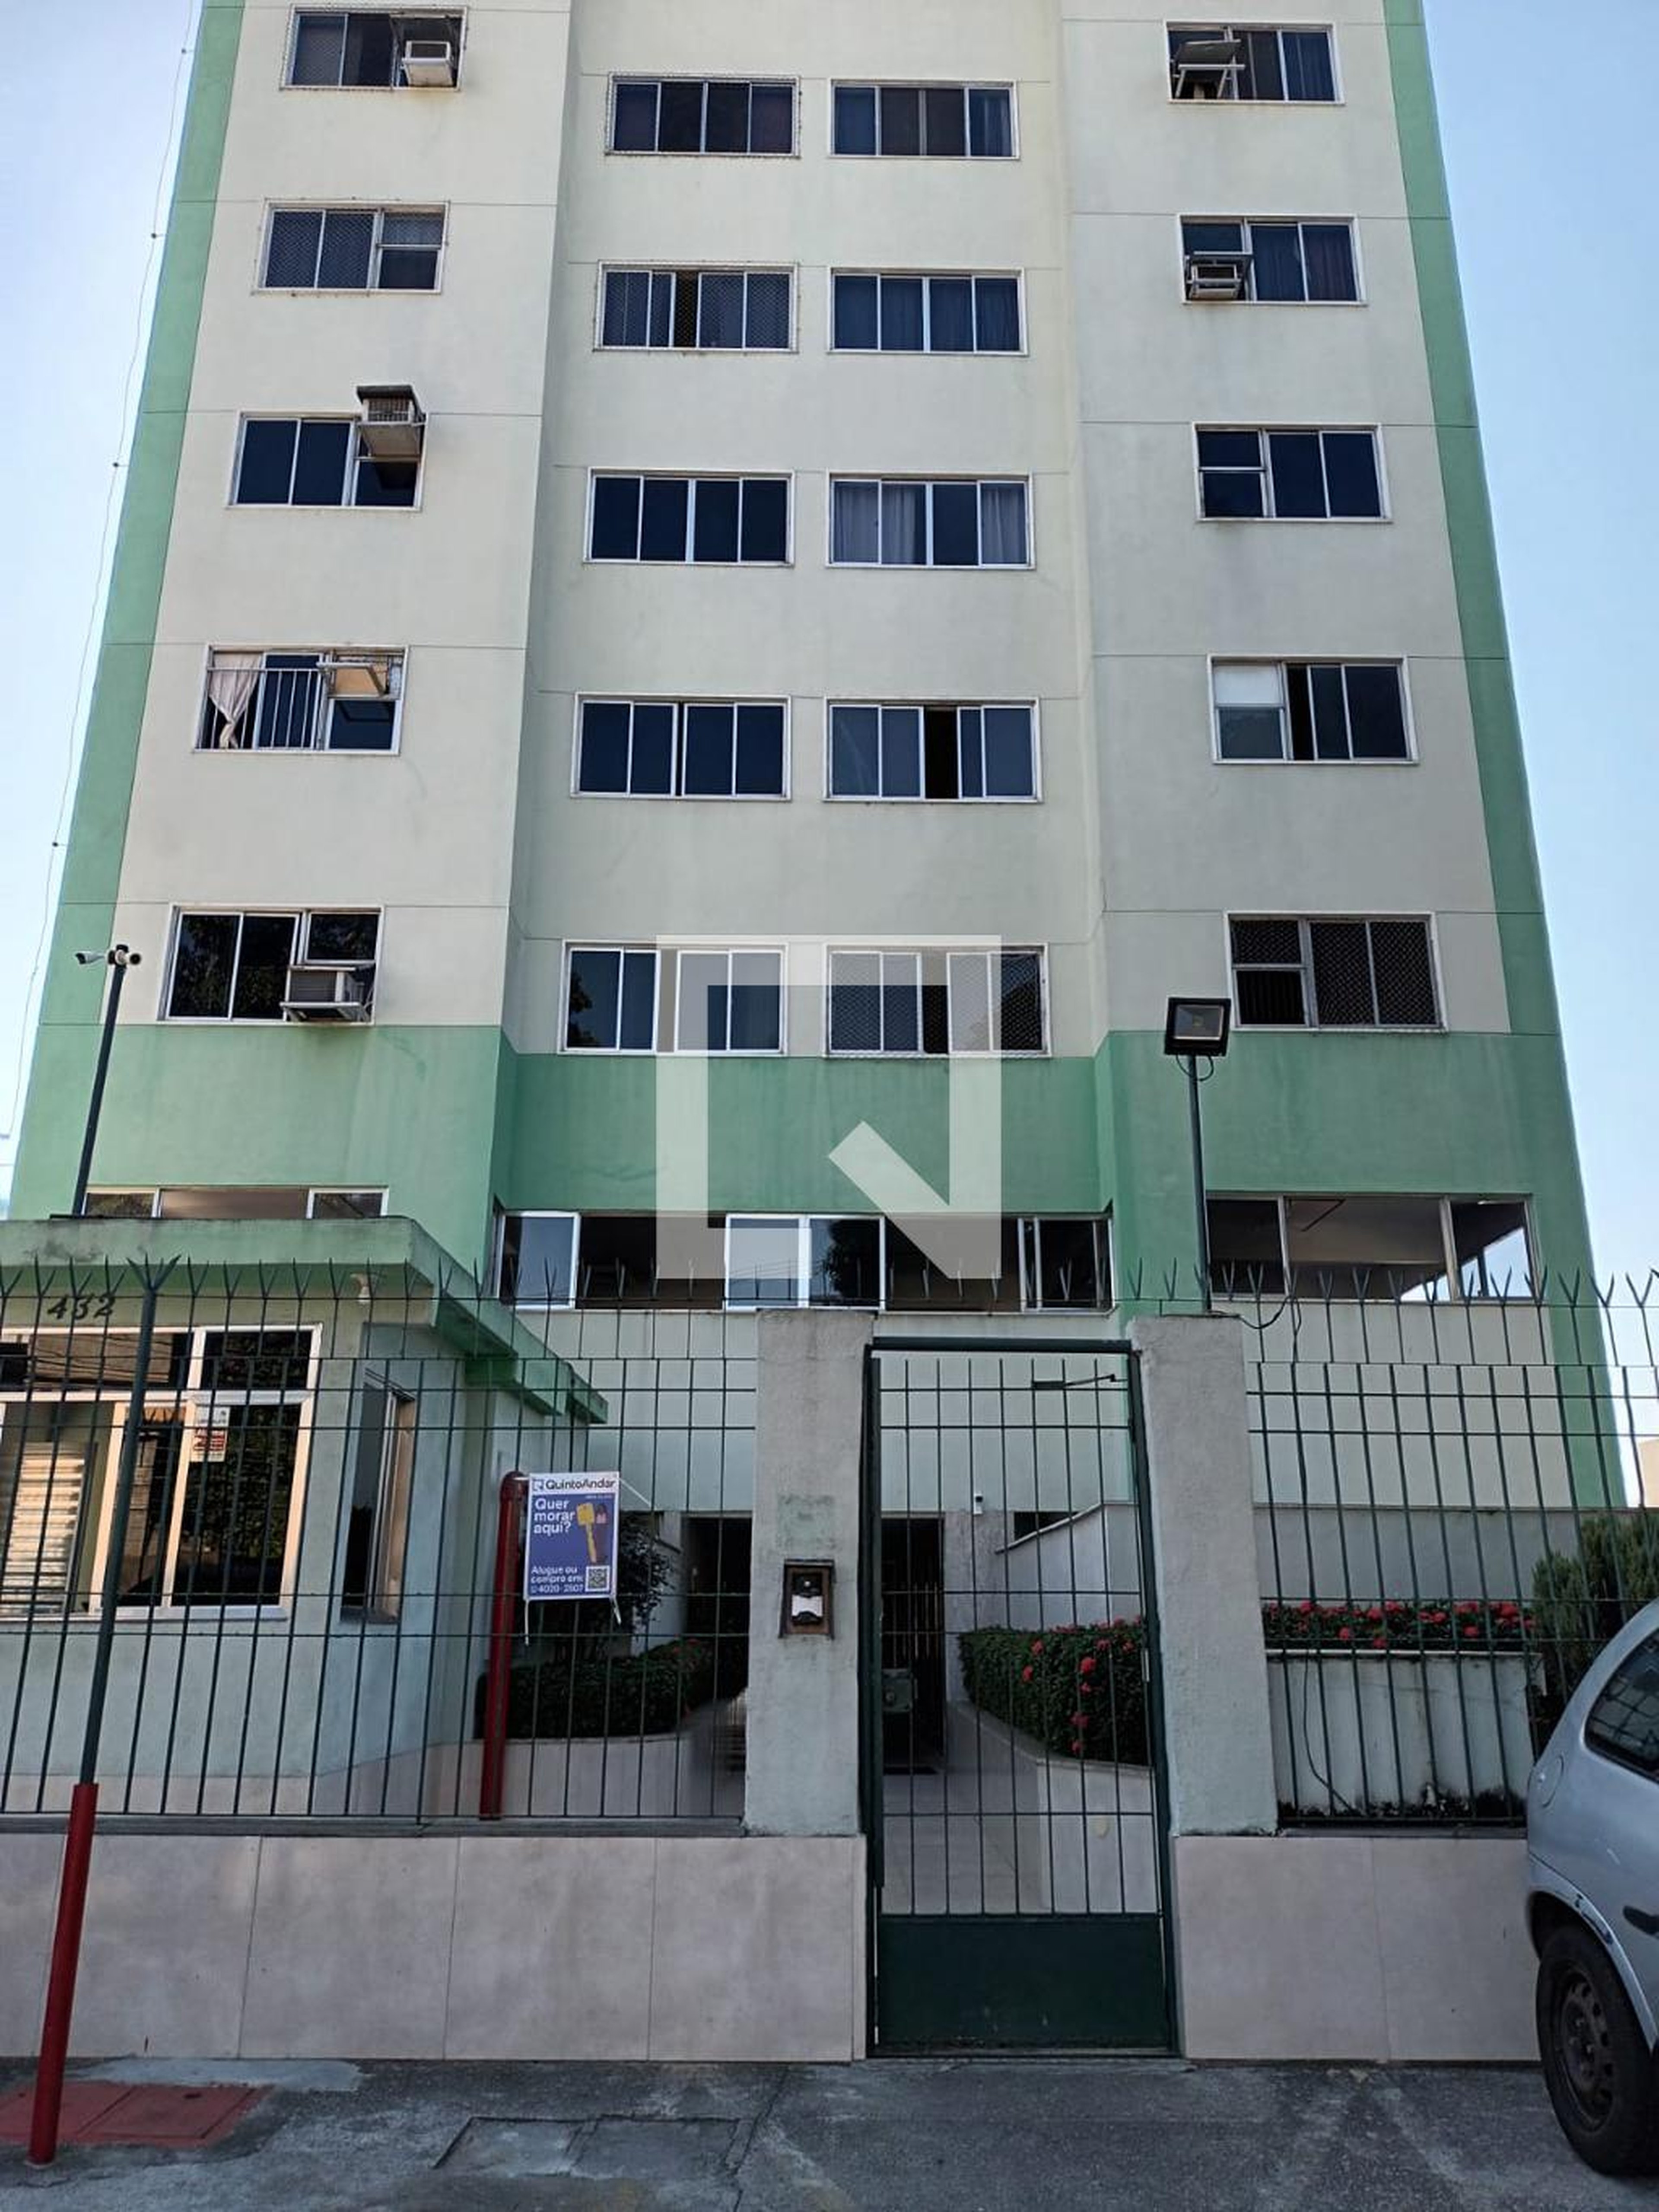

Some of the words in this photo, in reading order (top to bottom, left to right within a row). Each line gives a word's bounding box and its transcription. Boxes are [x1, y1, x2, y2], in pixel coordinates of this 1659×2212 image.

[47, 1293, 115, 1319] 452
[545, 1478, 615, 1490] QuintoAndar
[535, 1497, 570, 1510] Quer
[534, 1511, 575, 1521] morar
[534, 1521, 571, 1536] aqui?
[531, 1566, 564, 1576] Alugue
